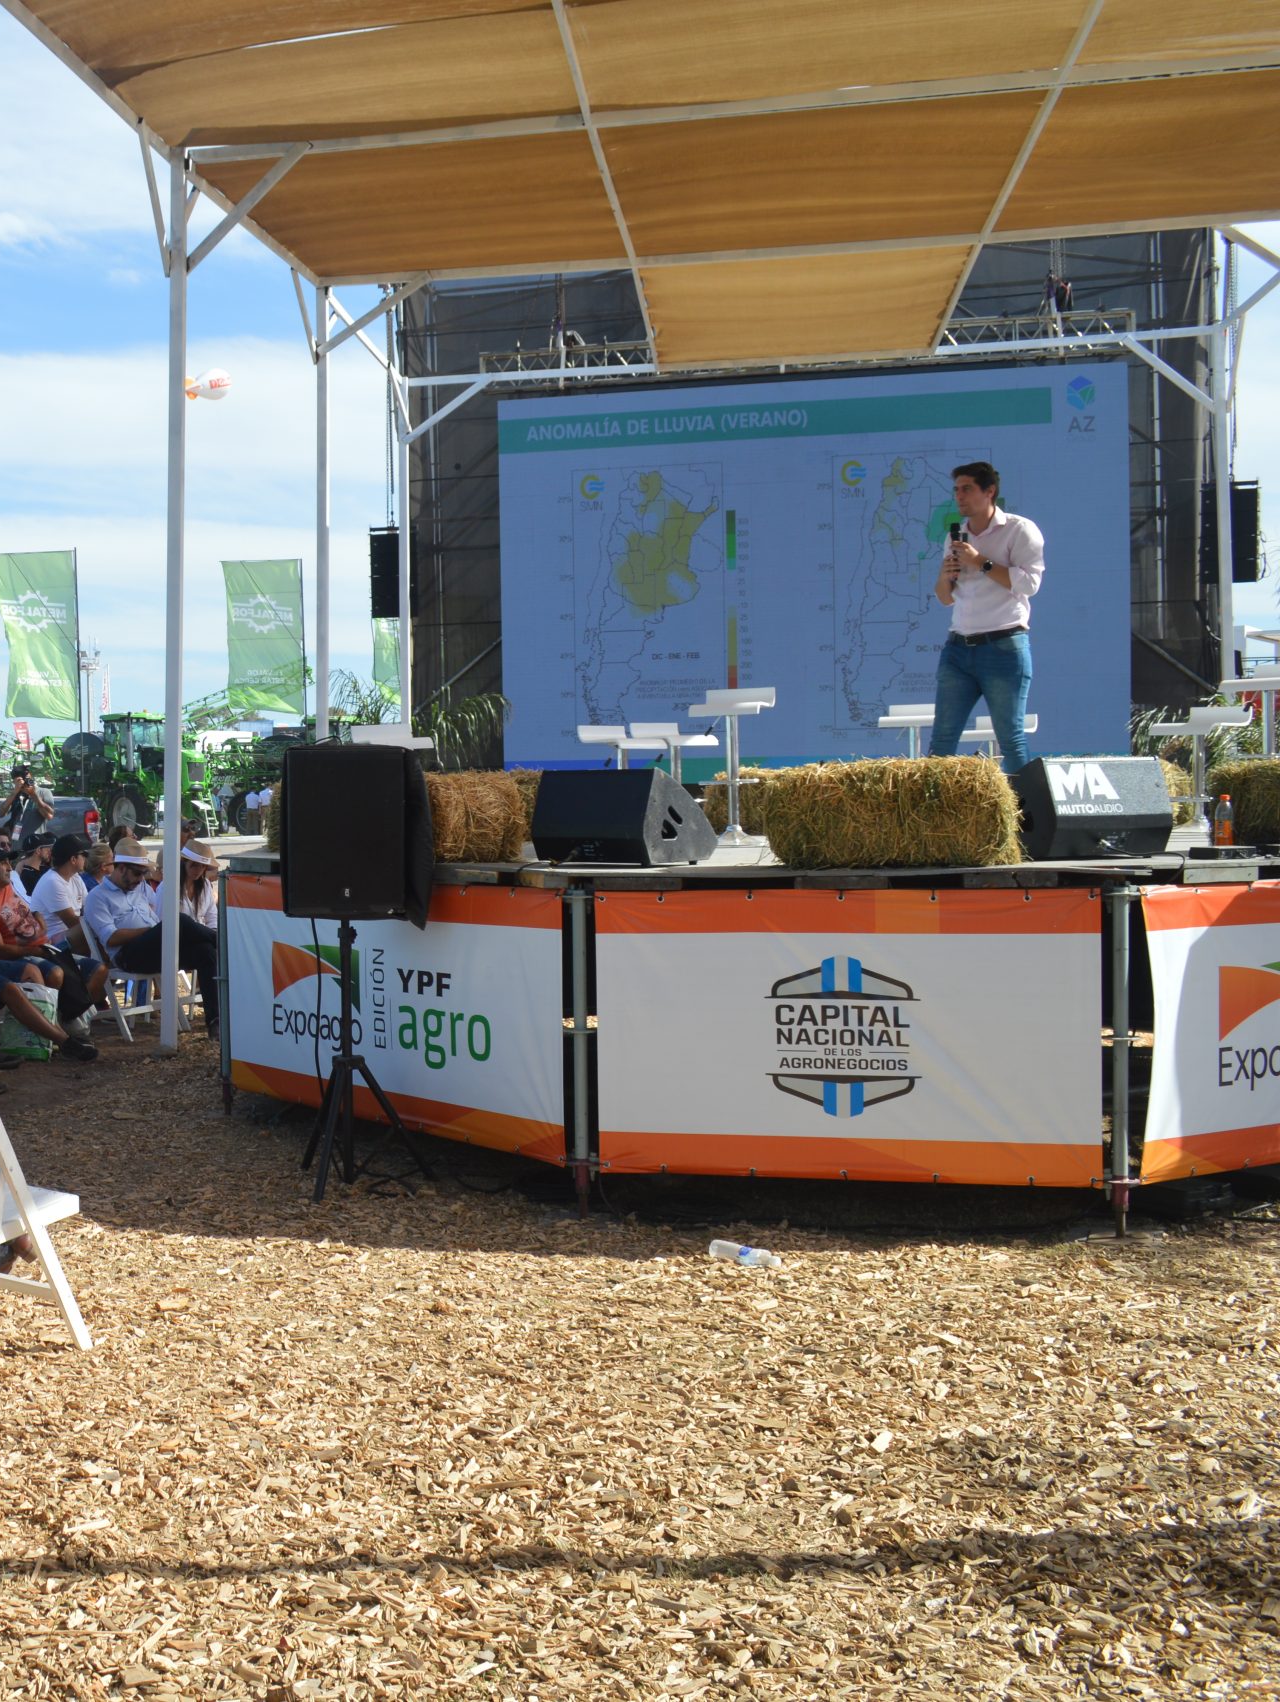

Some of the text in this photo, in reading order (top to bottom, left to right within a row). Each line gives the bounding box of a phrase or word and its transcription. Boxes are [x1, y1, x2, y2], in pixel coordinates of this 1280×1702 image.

[526, 409, 808, 441] ANOMALÍA DE LLUVIA (VERANO)
[1067, 415, 1096, 433] AZ
[840, 487, 865, 499] SMN
[579, 501, 603, 512] SMN
[1046, 763, 1120, 801] MA
[1057, 803, 1124, 815] MUTTOAUDIO
[396, 968, 452, 997] YPF
[371, 948, 387, 1049] EDICIÓN
[775, 1004, 910, 1028] CAPITAL
[272, 1003, 363, 1052] Expoago
[398, 1005, 491, 1070] agro
[776, 1028, 910, 1047] NACIONAL
[824, 1048, 862, 1056] DE LOS
[779, 1057, 908, 1071] AGRONEGOCIOS
